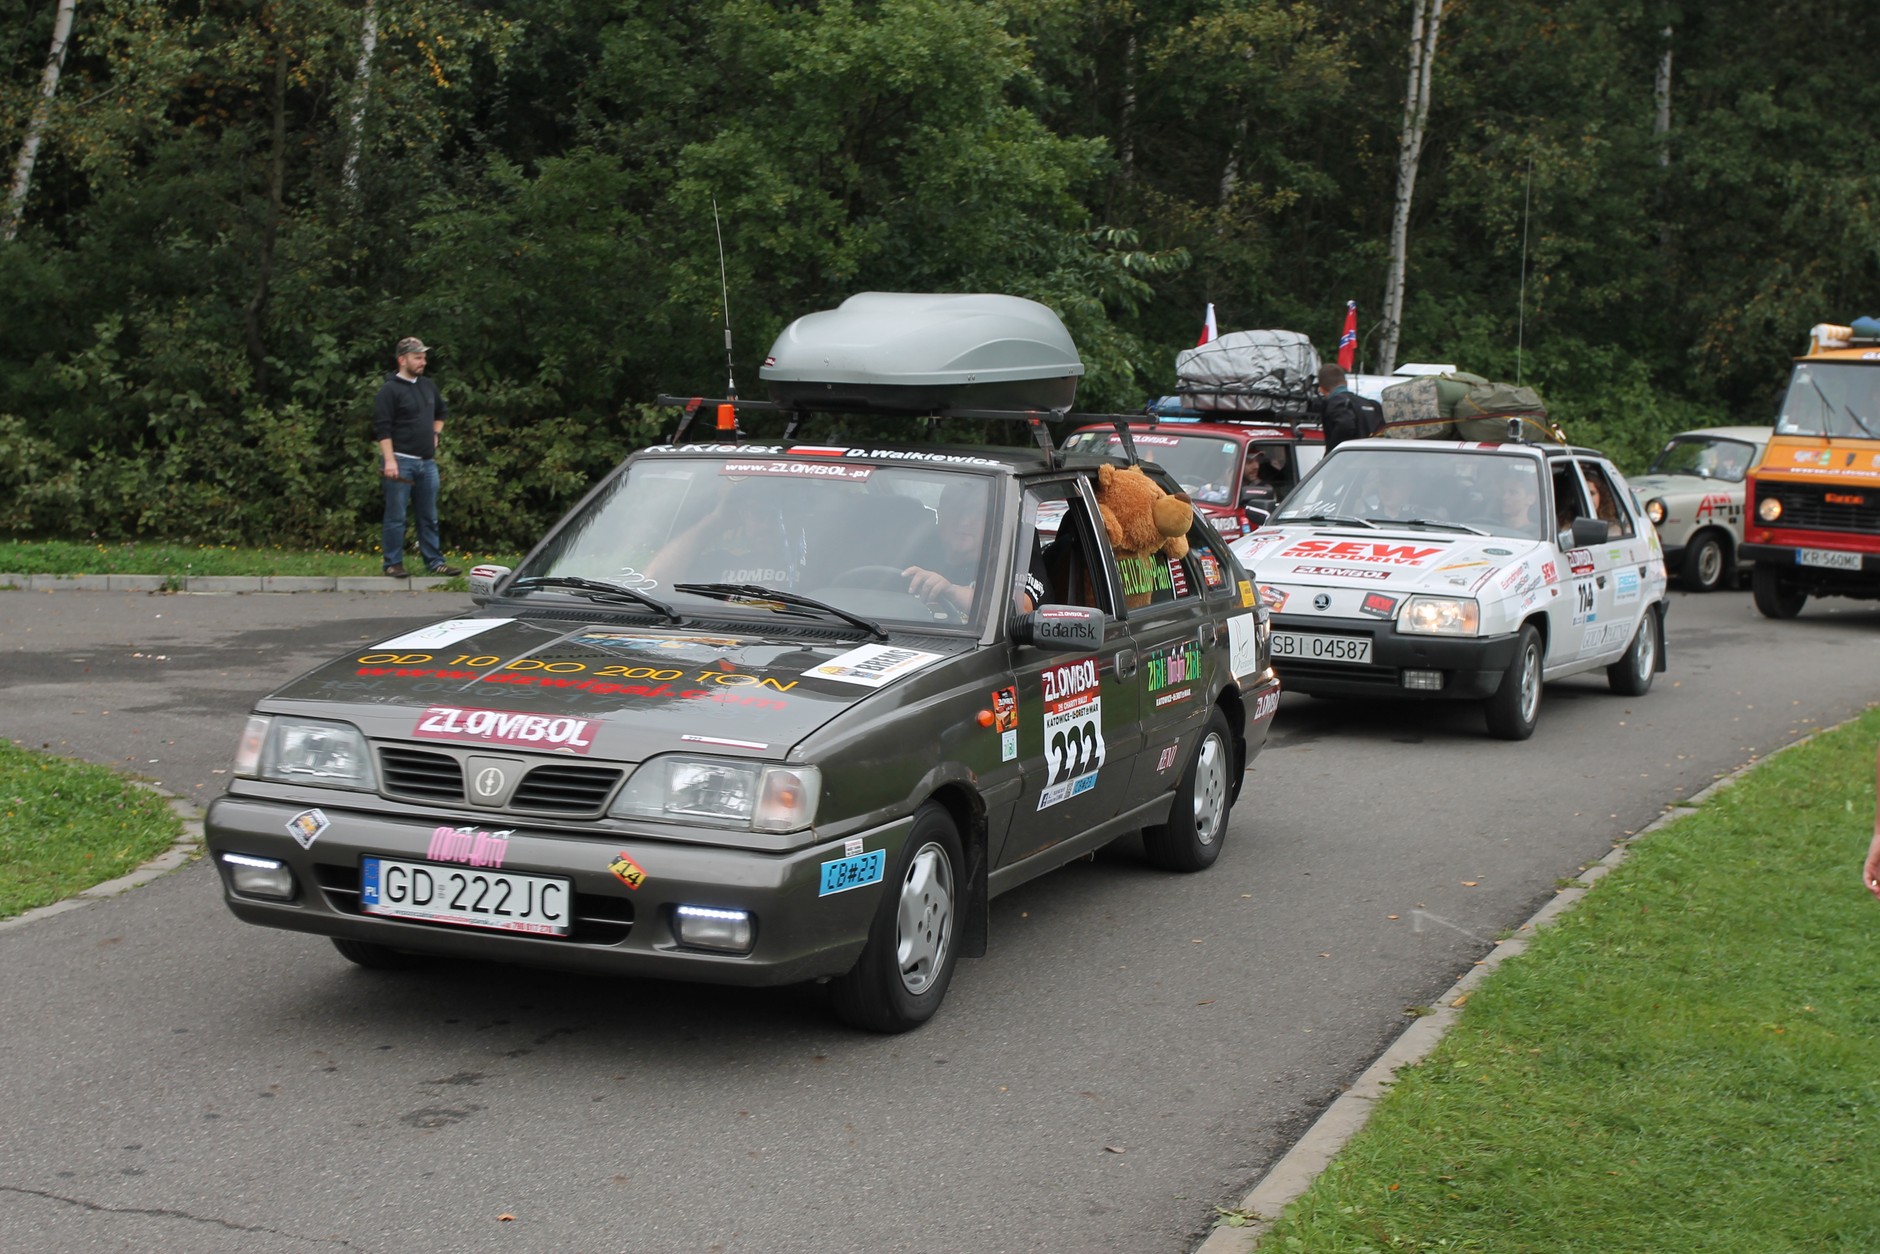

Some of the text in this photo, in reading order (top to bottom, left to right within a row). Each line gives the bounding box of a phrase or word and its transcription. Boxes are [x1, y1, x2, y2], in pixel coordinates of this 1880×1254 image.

[725, 462, 870, 478] www.ZLOMBOL.pl
[1280, 551, 1424, 566] EURODRIVE
[1289, 540, 1445, 561] SEW
[1295, 565, 1388, 578] ZLOMBOL
[1578, 582, 1593, 612] 114
[1041, 621, 1095, 639] Gdańsk
[1313, 638, 1368, 660] 04587
[358, 653, 800, 691] OD 10 DO 200 TON
[1042, 660, 1099, 702] ZLOMBOL
[418, 707, 590, 747] ZLOMBOL
[1051, 720, 1100, 786] 222
[620, 861, 641, 886] 14
[827, 855, 878, 890] CB#23
[364, 886, 379, 897] PL
[386, 866, 434, 906] GD
